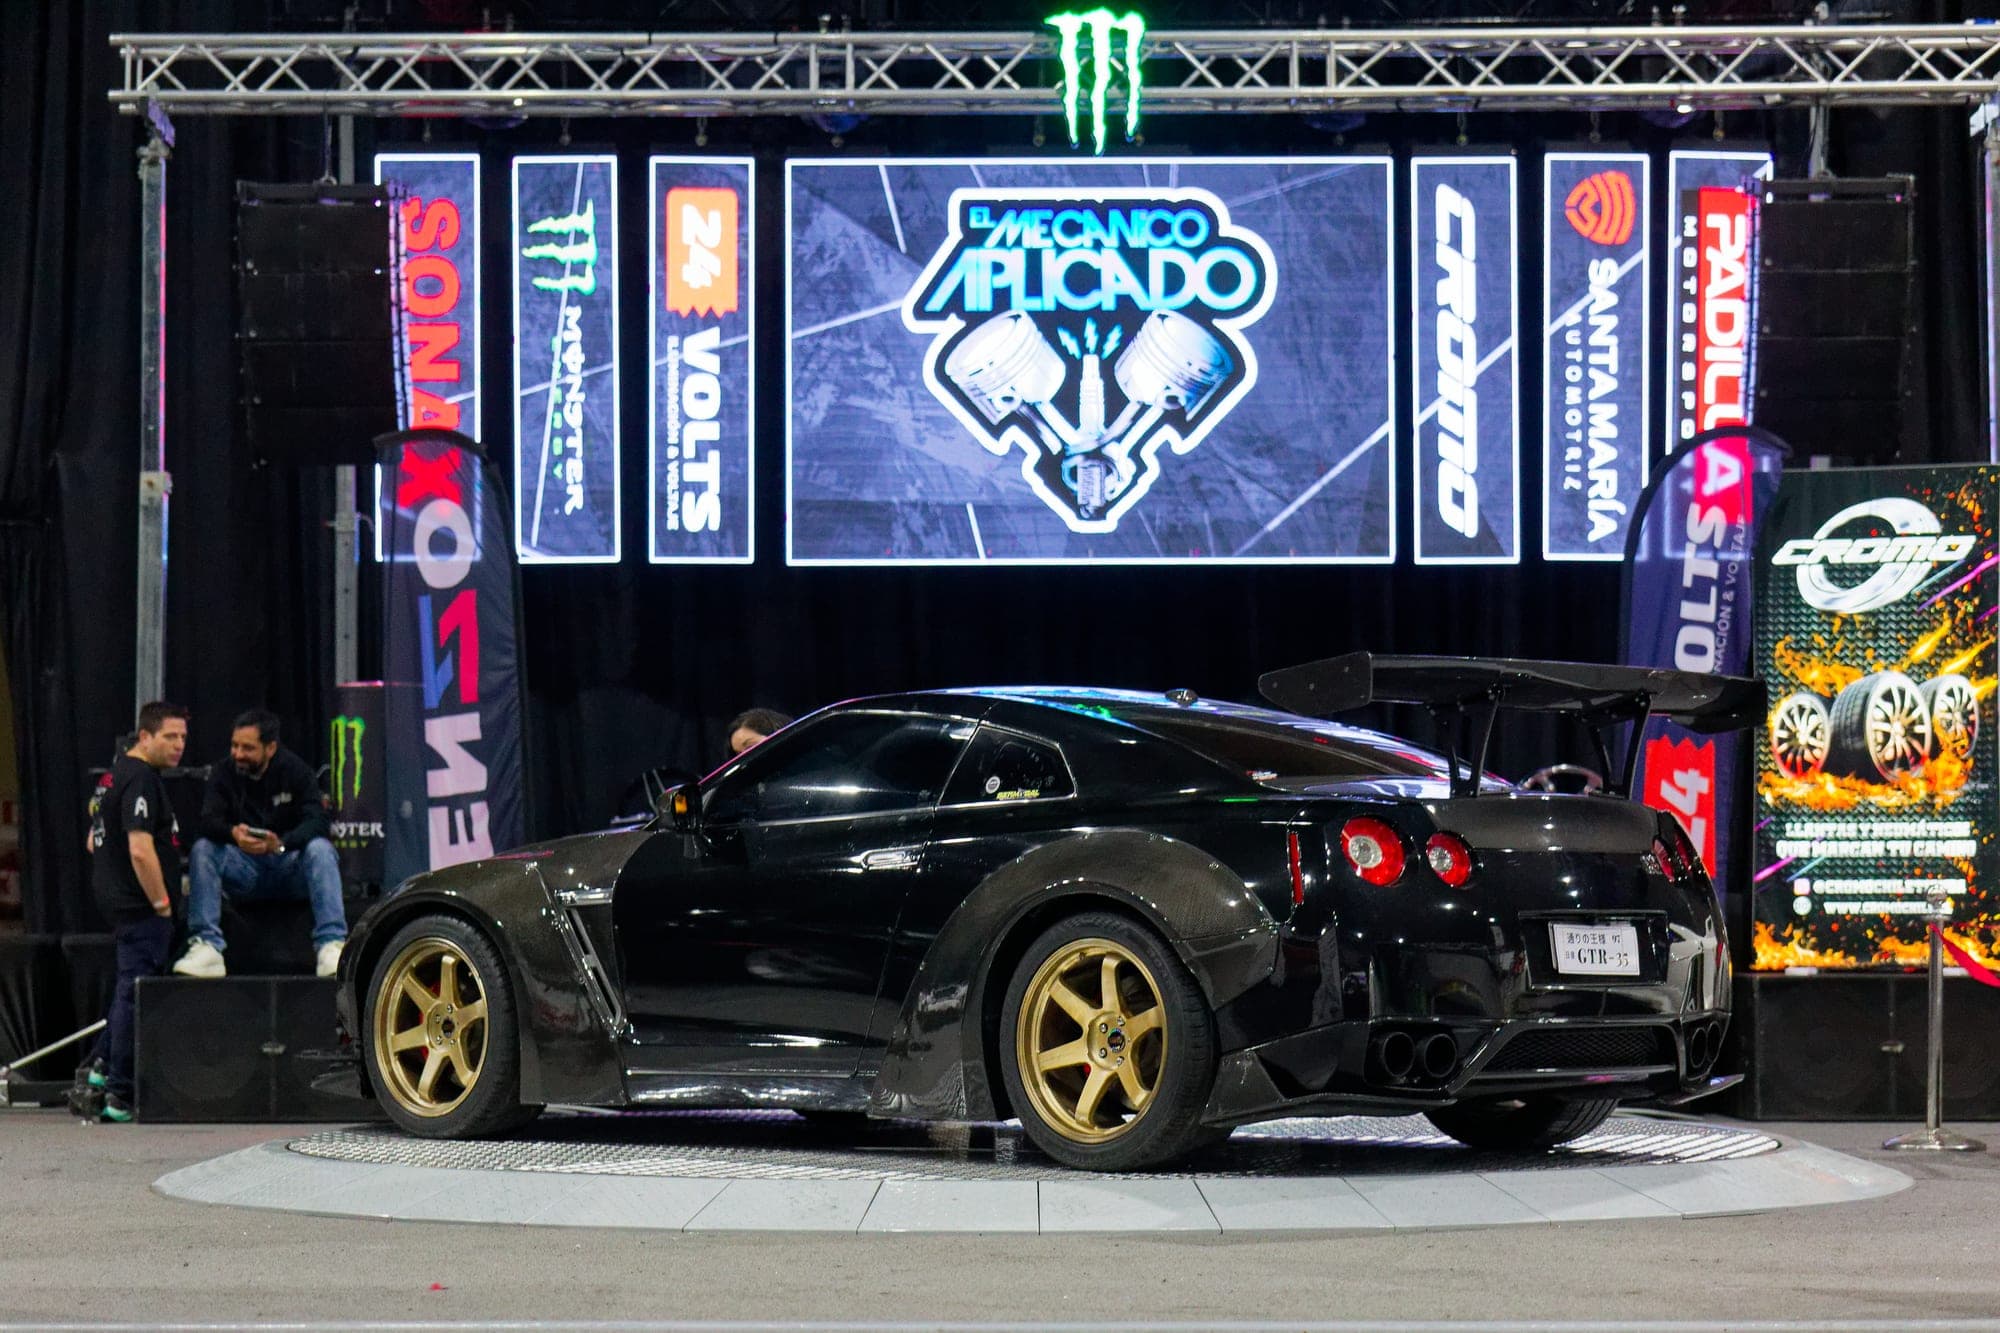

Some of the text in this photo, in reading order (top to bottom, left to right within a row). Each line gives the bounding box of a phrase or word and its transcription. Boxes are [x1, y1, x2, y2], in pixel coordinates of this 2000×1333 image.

[682, 203, 721, 289] 24
[924, 246, 1257, 312] APLICADO
[969, 206, 996, 229] EL
[399, 196, 461, 507] SONAX
[561, 304, 586, 516] MONSTER
[1435, 183, 1478, 538] CROMO
[1564, 311, 1582, 491] AUTOMOTRIZ
[682, 326, 721, 532] VOLTS
[1674, 501, 1727, 674] OLTS
[1722, 588, 1735, 602] &
[1771, 535, 1977, 566] CROMO
[1578, 949, 1629, 968] GTR-35
